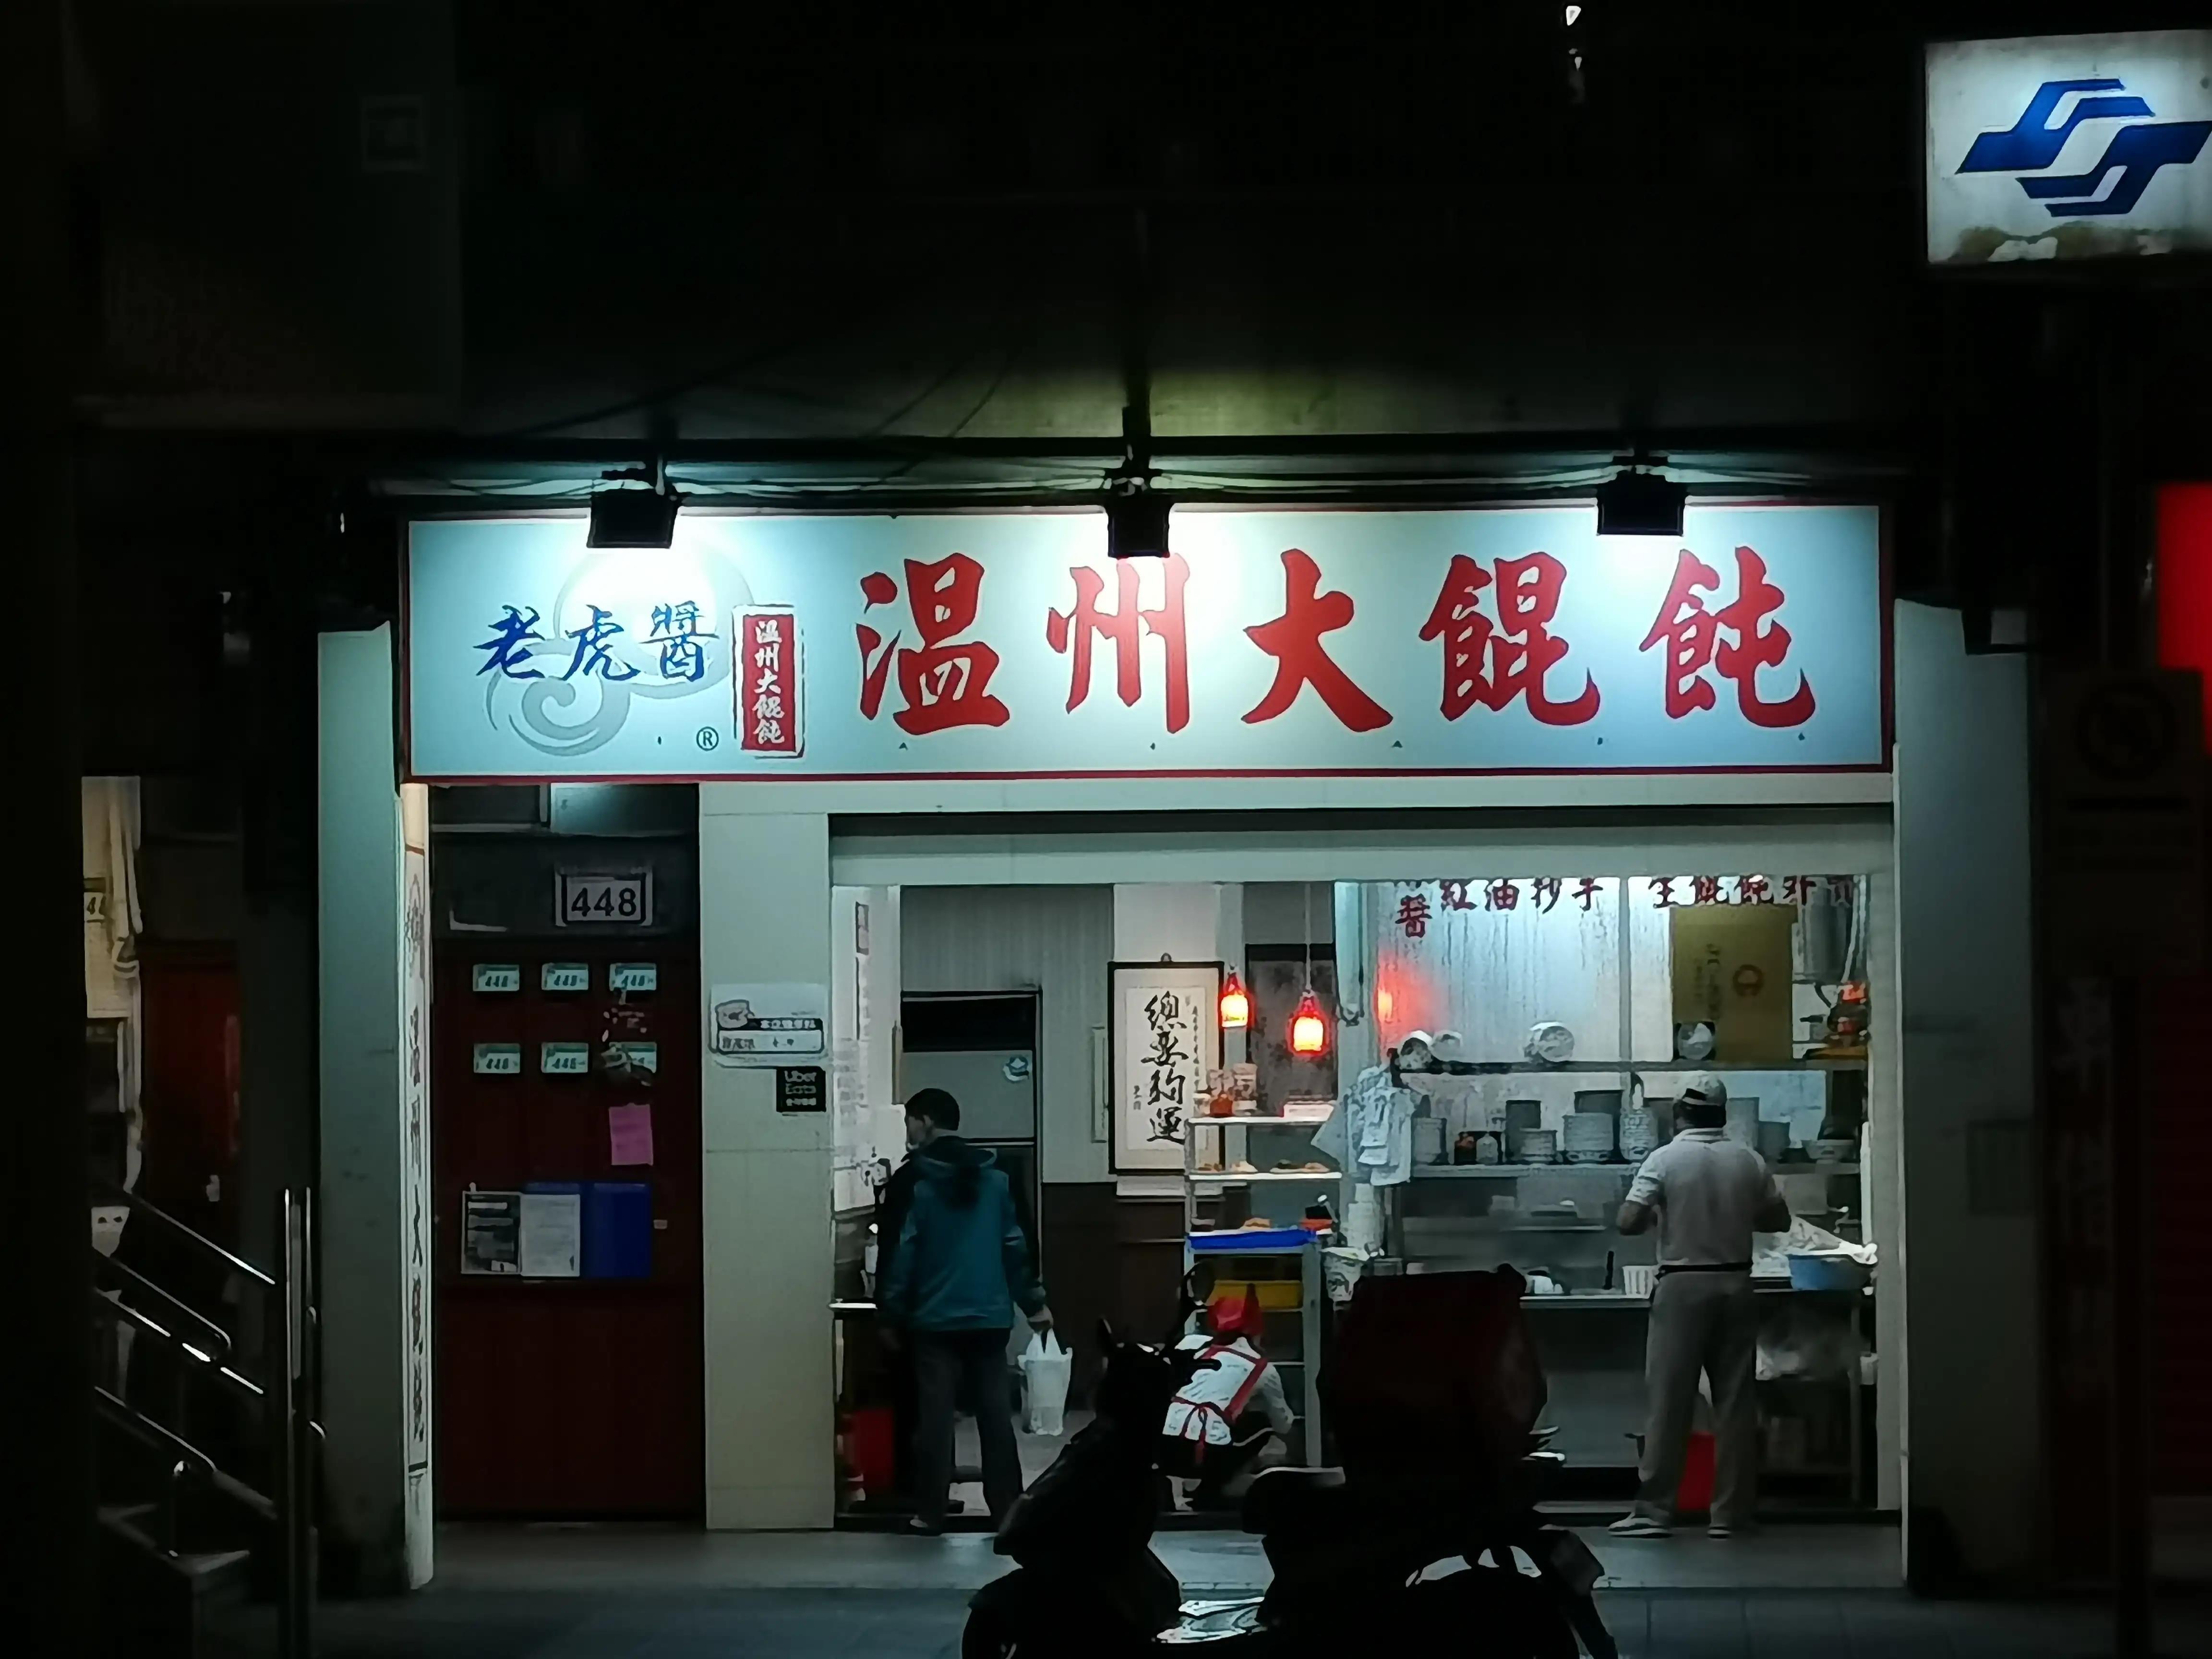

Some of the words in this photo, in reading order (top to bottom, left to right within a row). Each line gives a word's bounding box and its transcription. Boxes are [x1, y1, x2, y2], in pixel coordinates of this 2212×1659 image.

[473, 600, 720, 683] 老虎醬
[571, 888, 637, 916] 448
